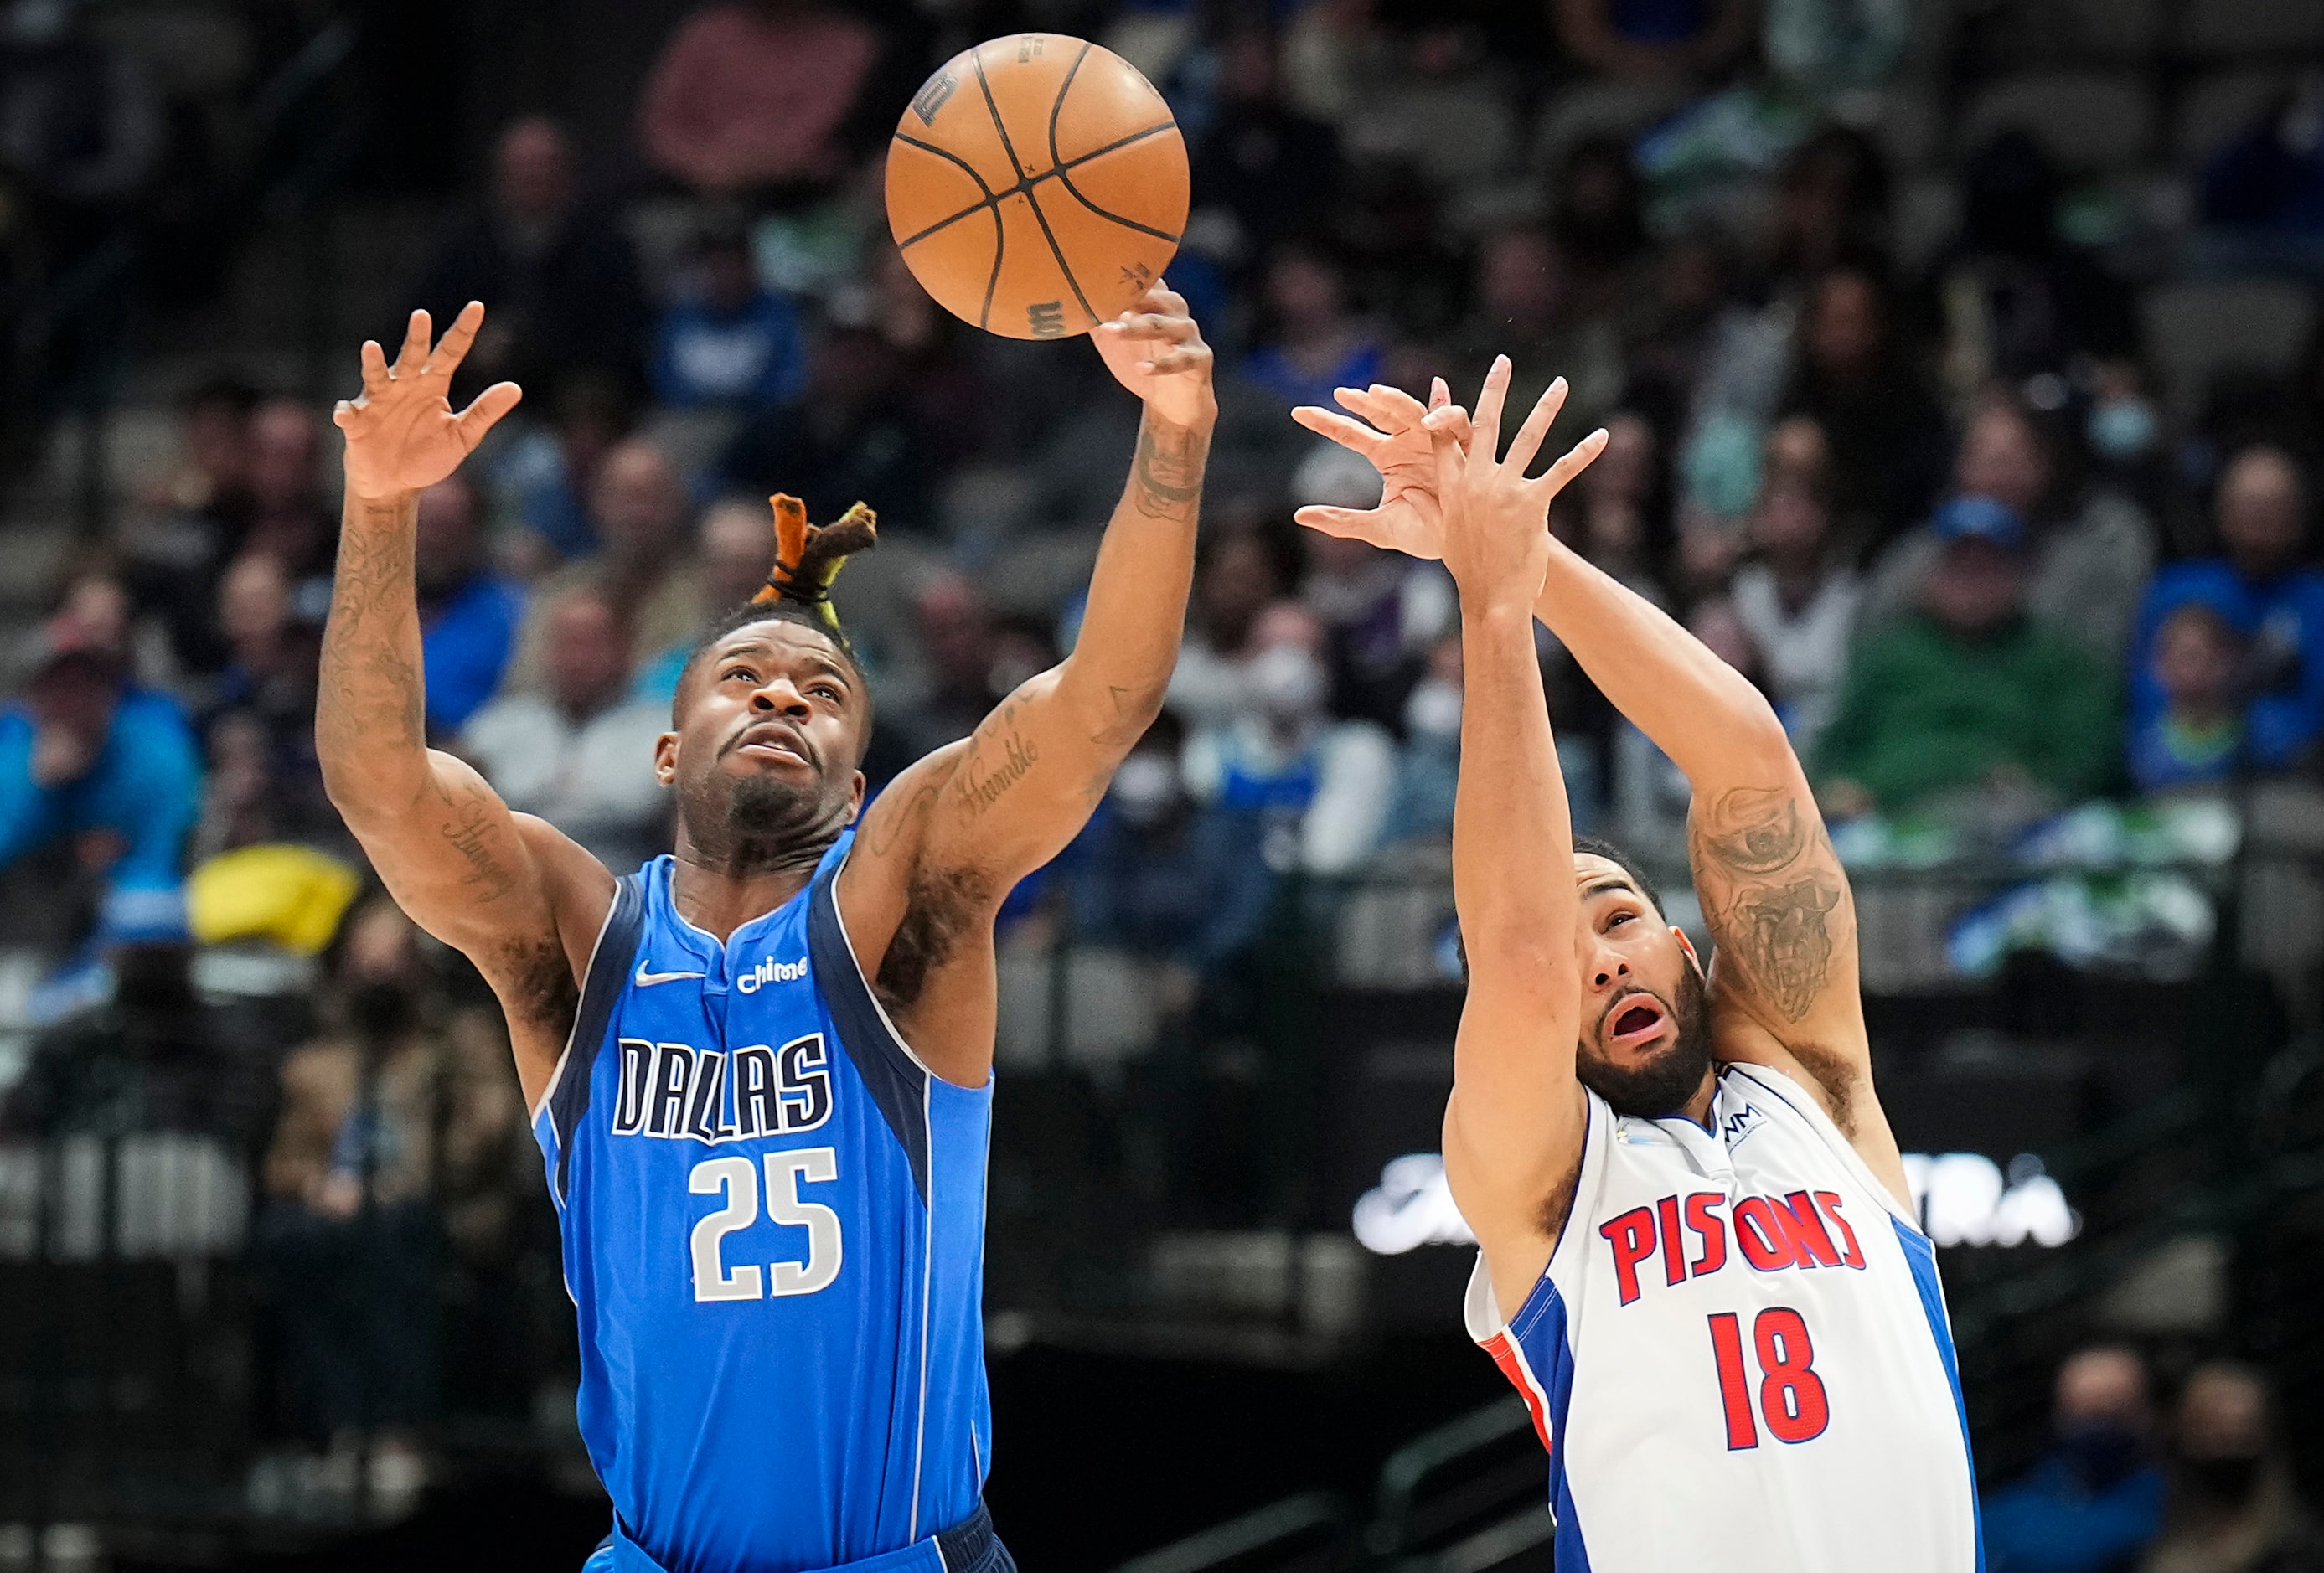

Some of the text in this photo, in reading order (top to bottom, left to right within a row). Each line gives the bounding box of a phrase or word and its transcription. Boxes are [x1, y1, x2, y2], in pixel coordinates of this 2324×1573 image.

[737, 955, 808, 994] chime
[611, 1032, 834, 1146] DALLAS
[1724, 1102, 1762, 1143] WM
[689, 1147, 843, 1302] 25
[1599, 1190, 1867, 1307] PISONS
[1707, 1307, 1829, 1451] 18
